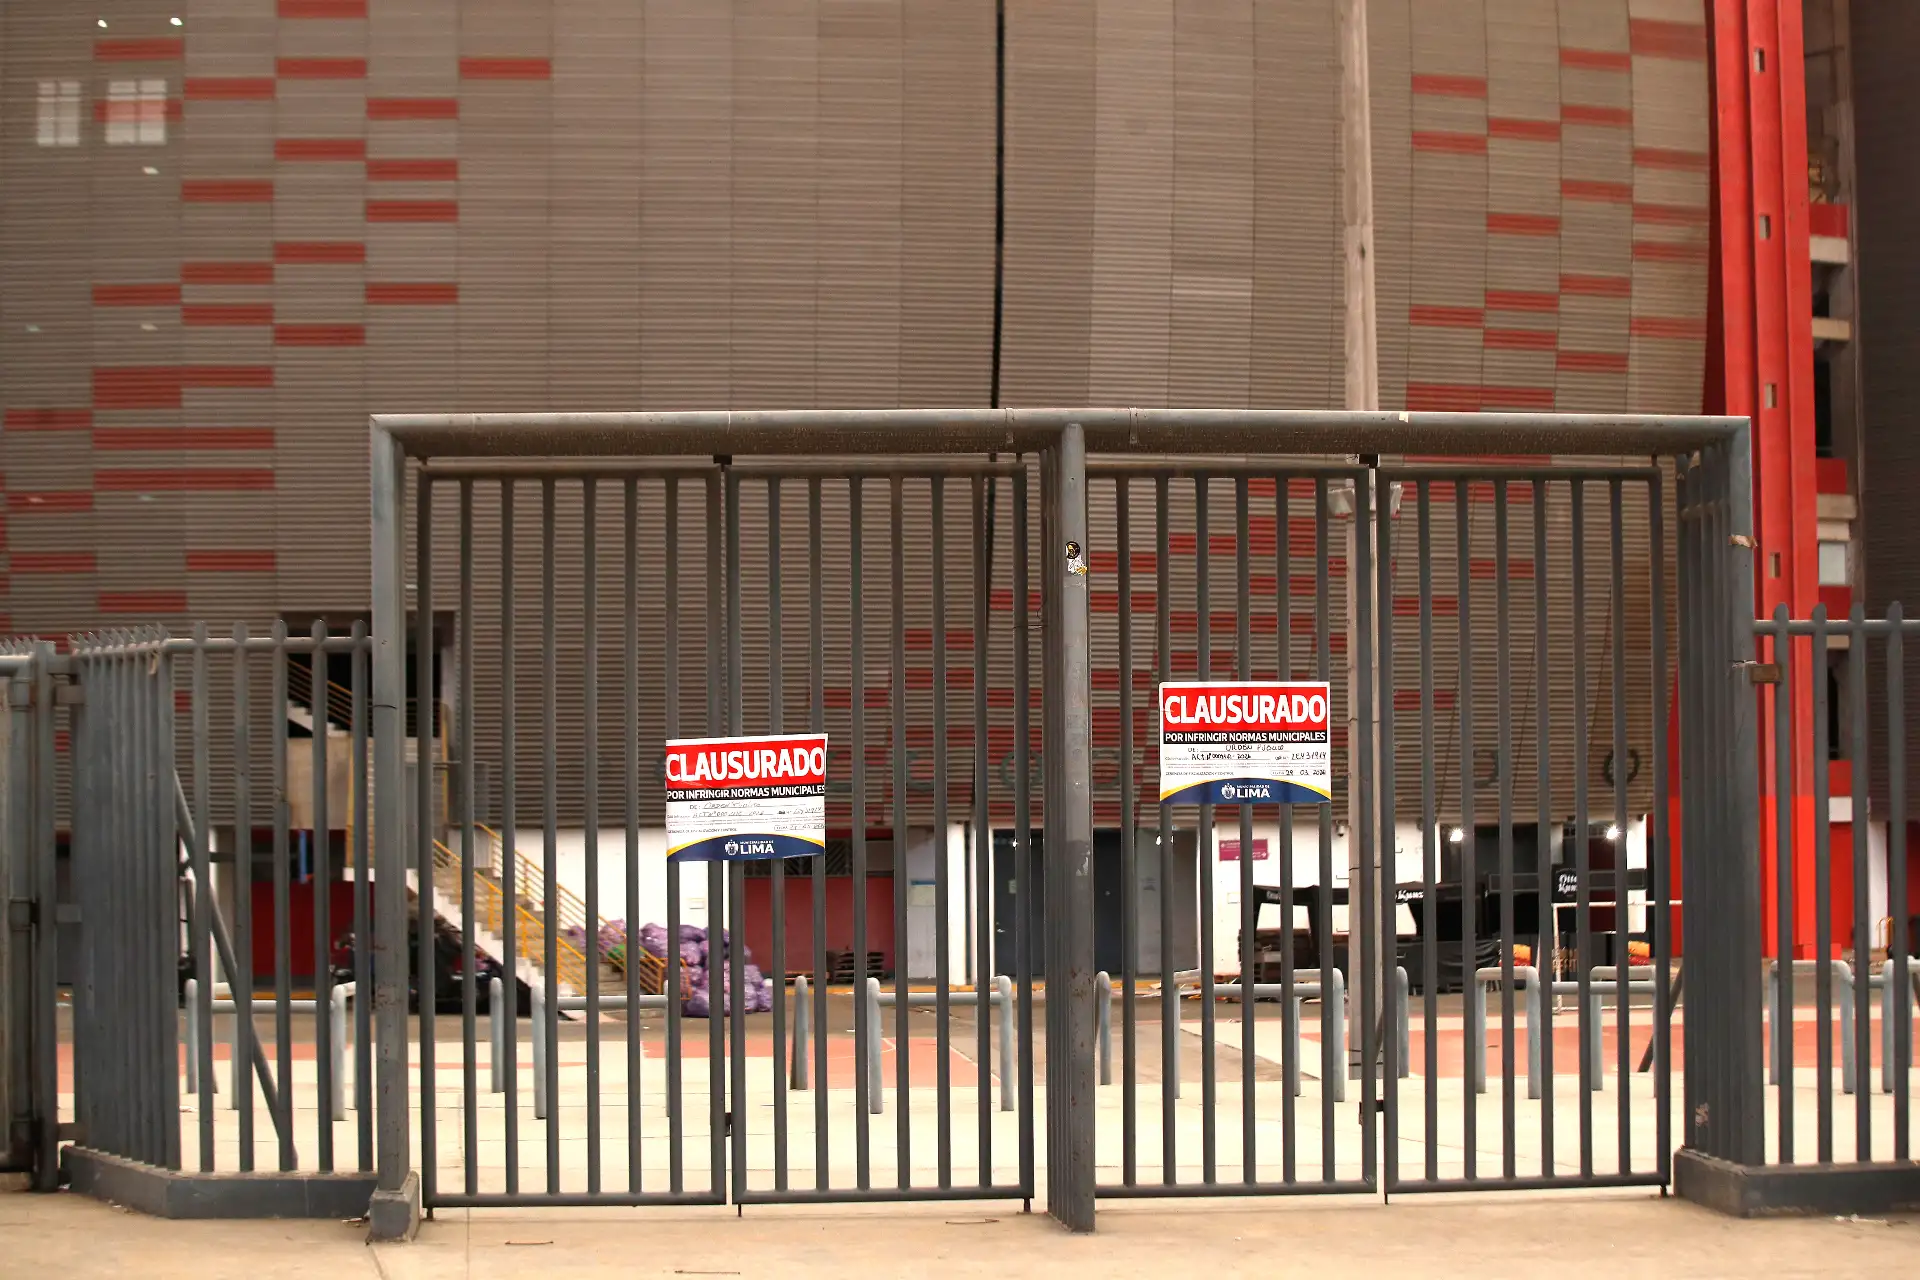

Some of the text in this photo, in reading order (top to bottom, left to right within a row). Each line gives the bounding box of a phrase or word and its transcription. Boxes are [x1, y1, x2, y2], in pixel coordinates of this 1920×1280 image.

[1165, 694, 1326, 724] CLAUSURADO
[1166, 732, 1326, 742] POR INFRINGIR NORMAS MUNICIPALES
[667, 747, 824, 782] CLAUSURADO
[667, 785, 825, 800] POR INFRINGIR NORMAS MUNICIPALES
[1237, 788, 1270, 798] LIMA
[740, 844, 774, 854] LIMA
